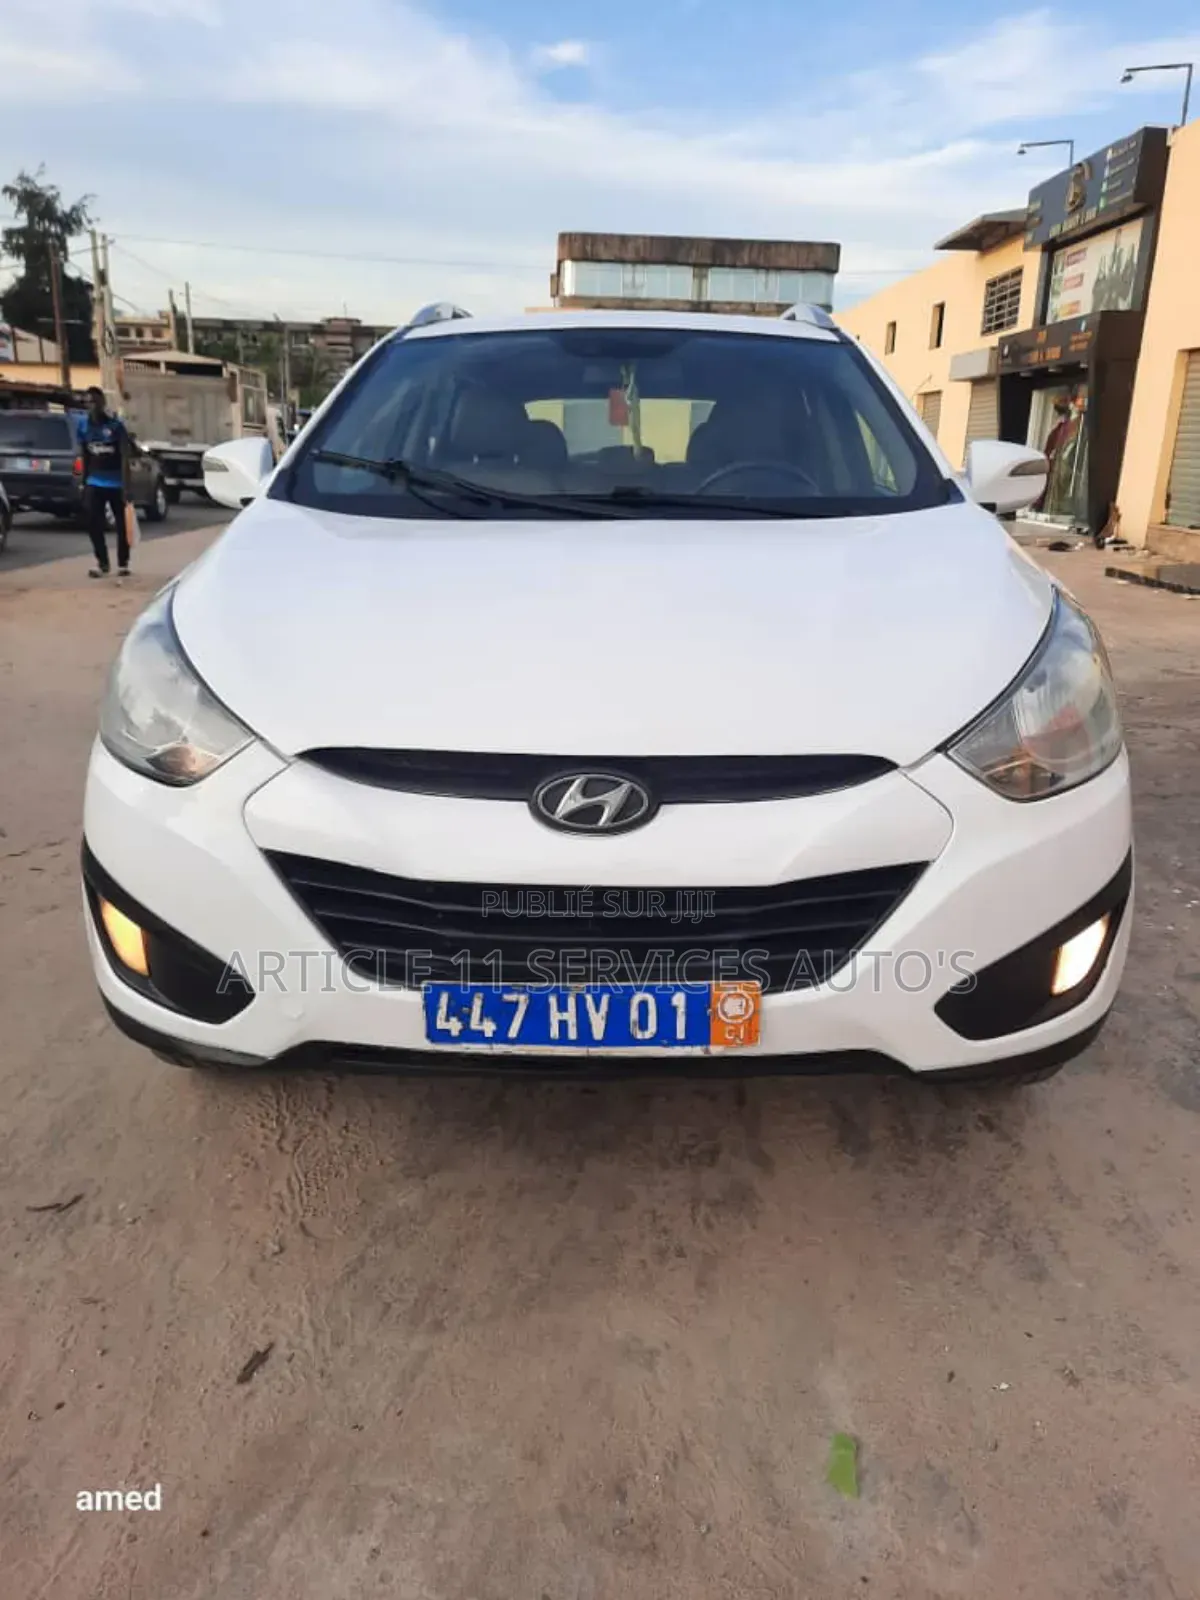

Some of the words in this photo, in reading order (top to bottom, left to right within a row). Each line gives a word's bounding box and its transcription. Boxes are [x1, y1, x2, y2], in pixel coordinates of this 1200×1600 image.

[436, 991, 529, 1039] 447
[549, 994, 610, 1041] HV
[629, 991, 687, 1041] 01
